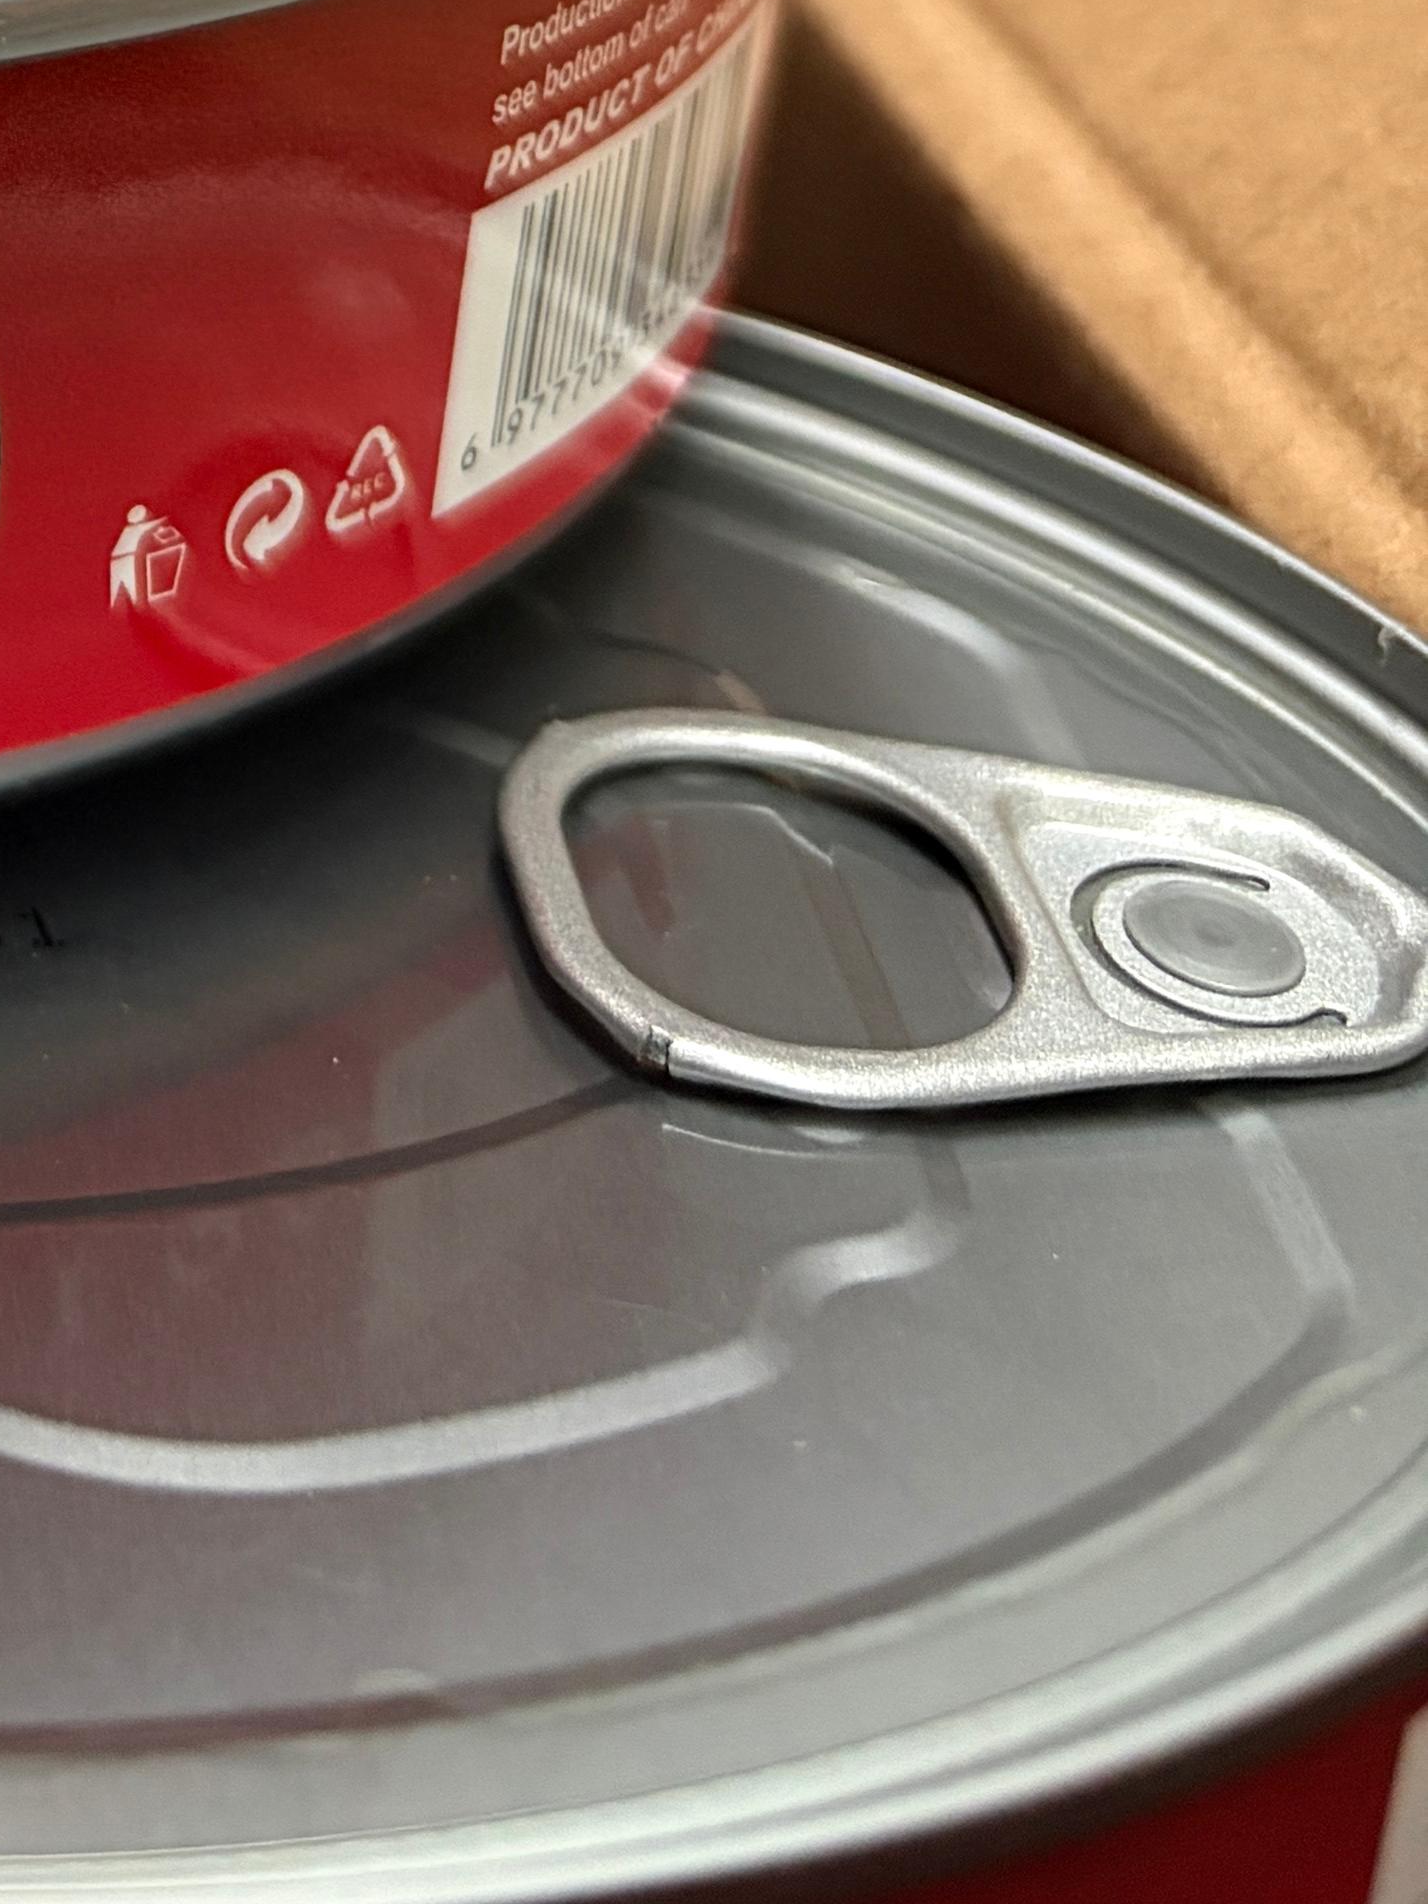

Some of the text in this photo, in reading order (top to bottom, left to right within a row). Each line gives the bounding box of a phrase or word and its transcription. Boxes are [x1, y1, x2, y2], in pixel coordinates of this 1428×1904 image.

[483, 63, 653, 192] PRODUCT
[654, 30, 694, 90] OF
[491, 78, 536, 125] see
[543, 30, 624, 100] bottom
[629, 11, 655, 49] of
[460, 431, 478, 472] 6
